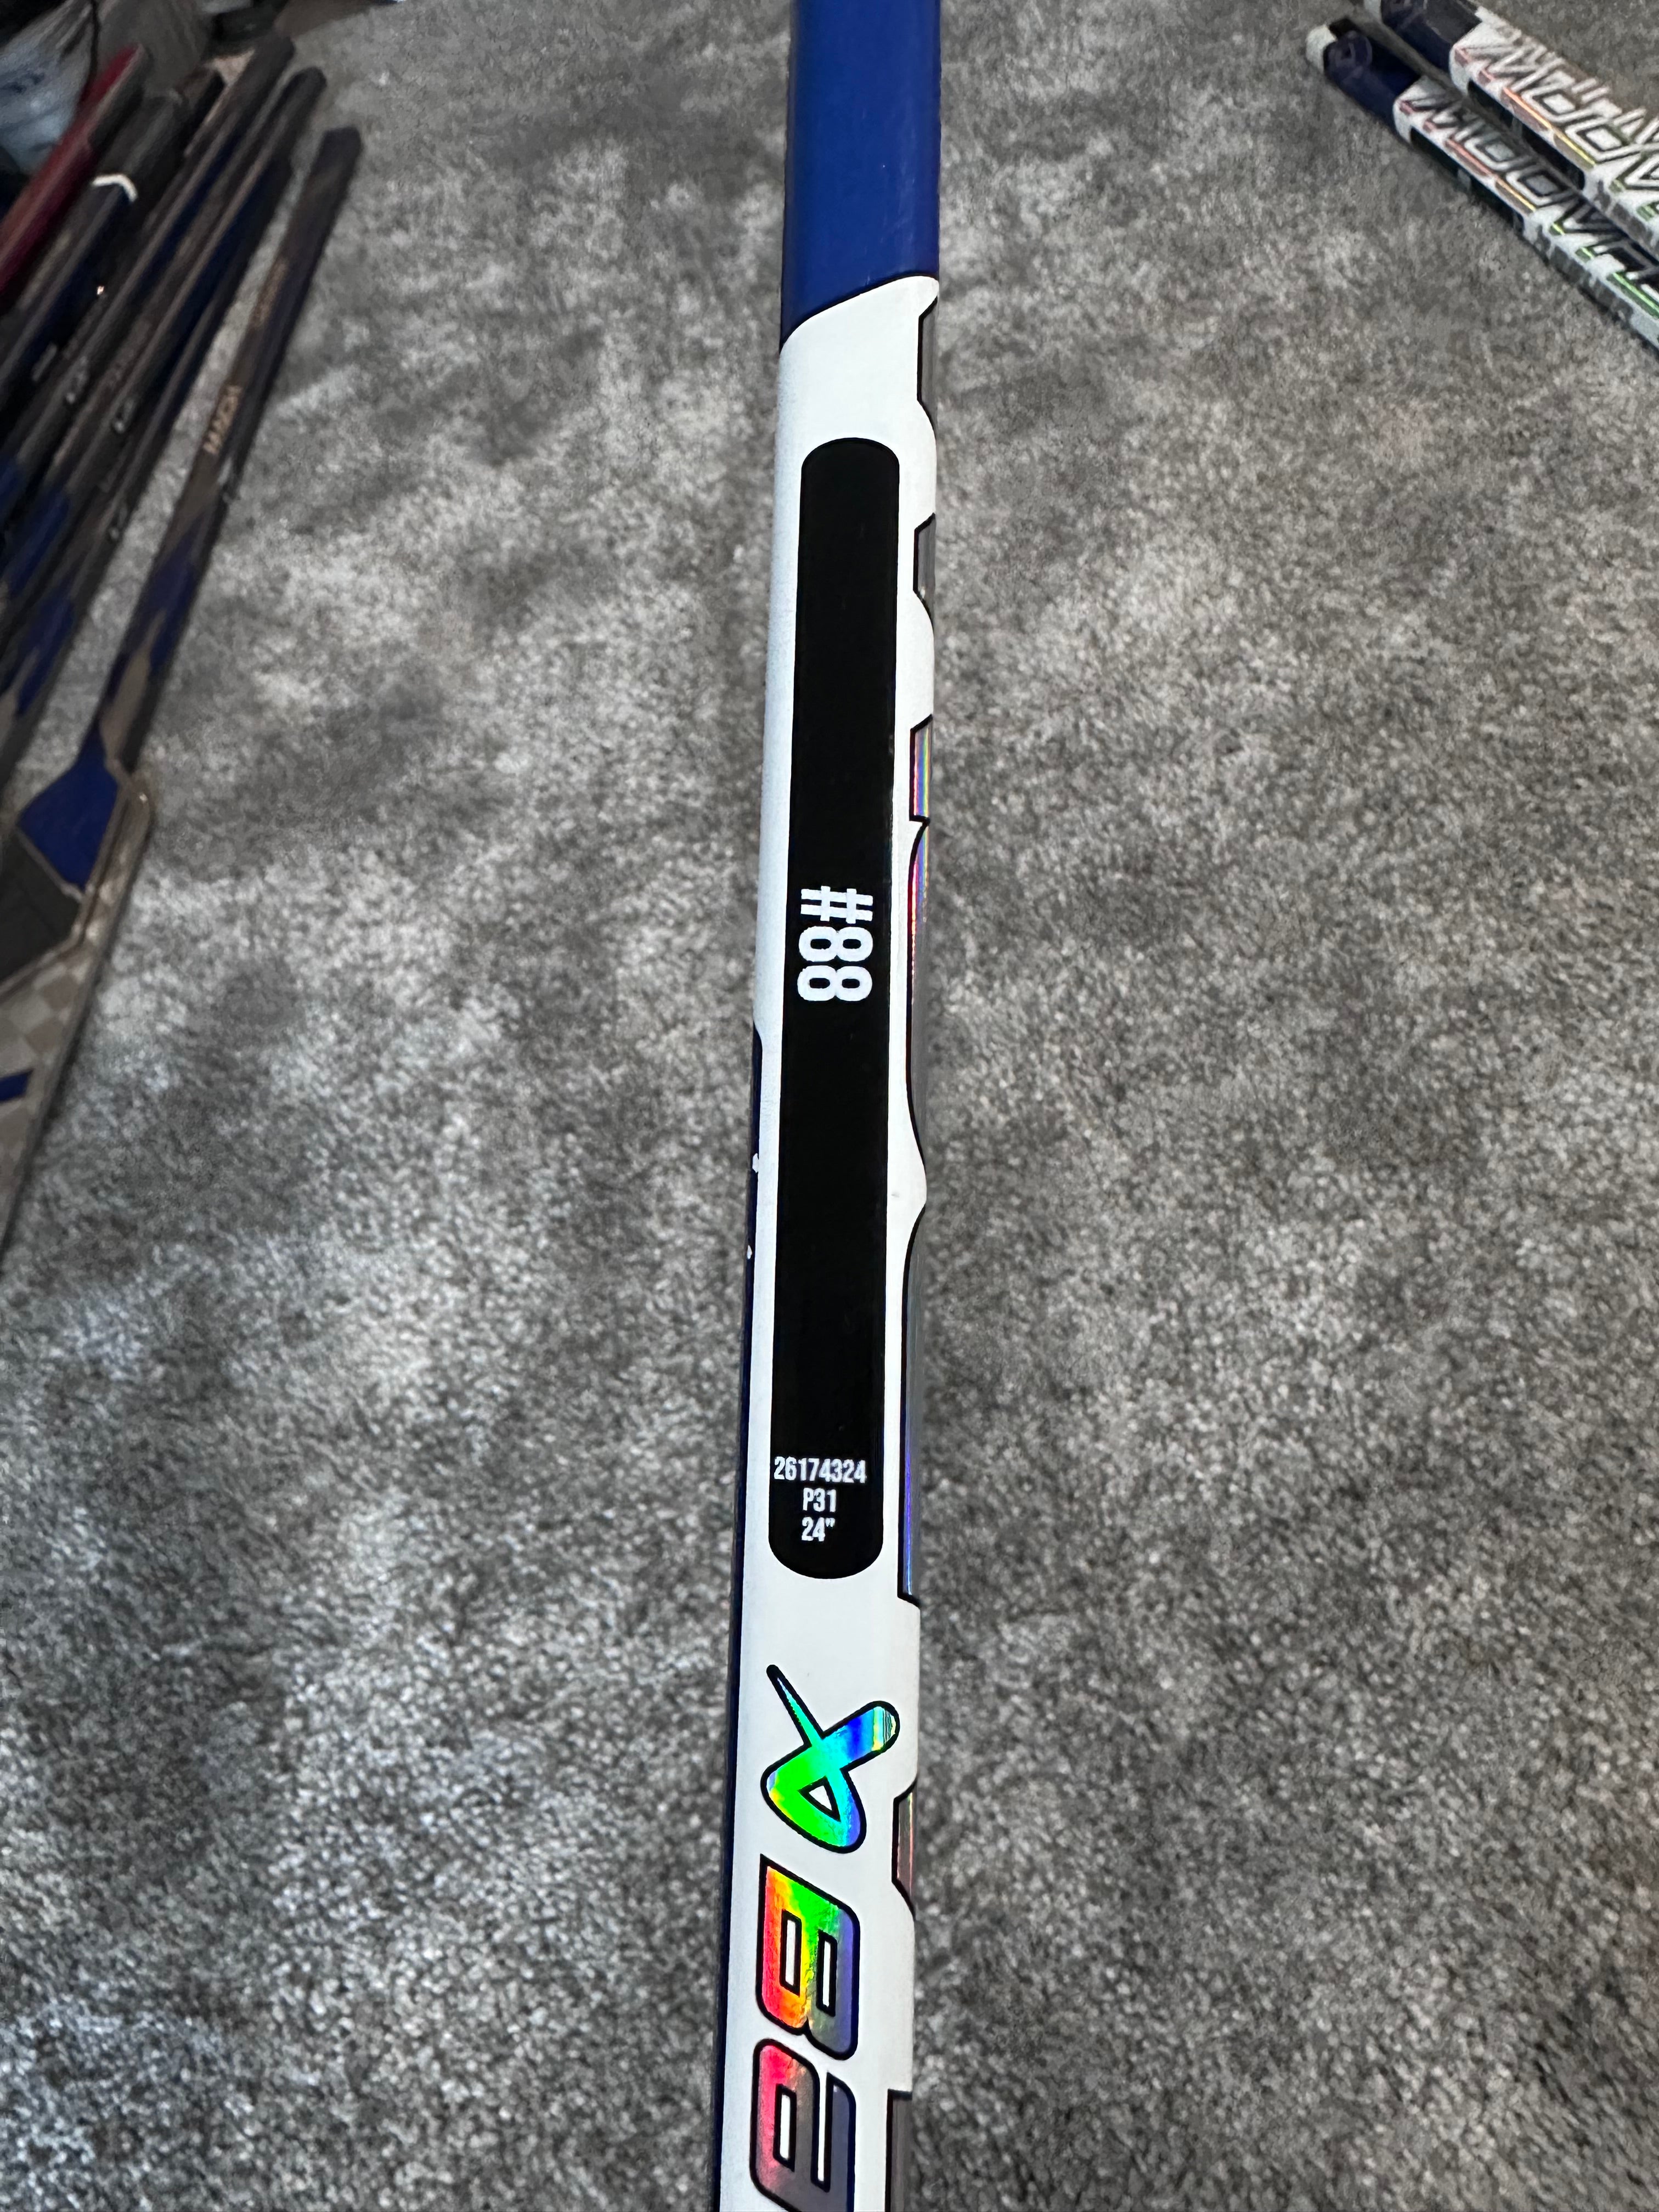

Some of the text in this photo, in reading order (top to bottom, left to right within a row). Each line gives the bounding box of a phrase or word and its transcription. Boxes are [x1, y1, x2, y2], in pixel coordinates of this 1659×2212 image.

[797, 885, 873, 1001] #88
[774, 1456, 867, 1483] 26174324
[803, 1487, 837, 1513] P31
[802, 1516, 836, 1542] 24"
